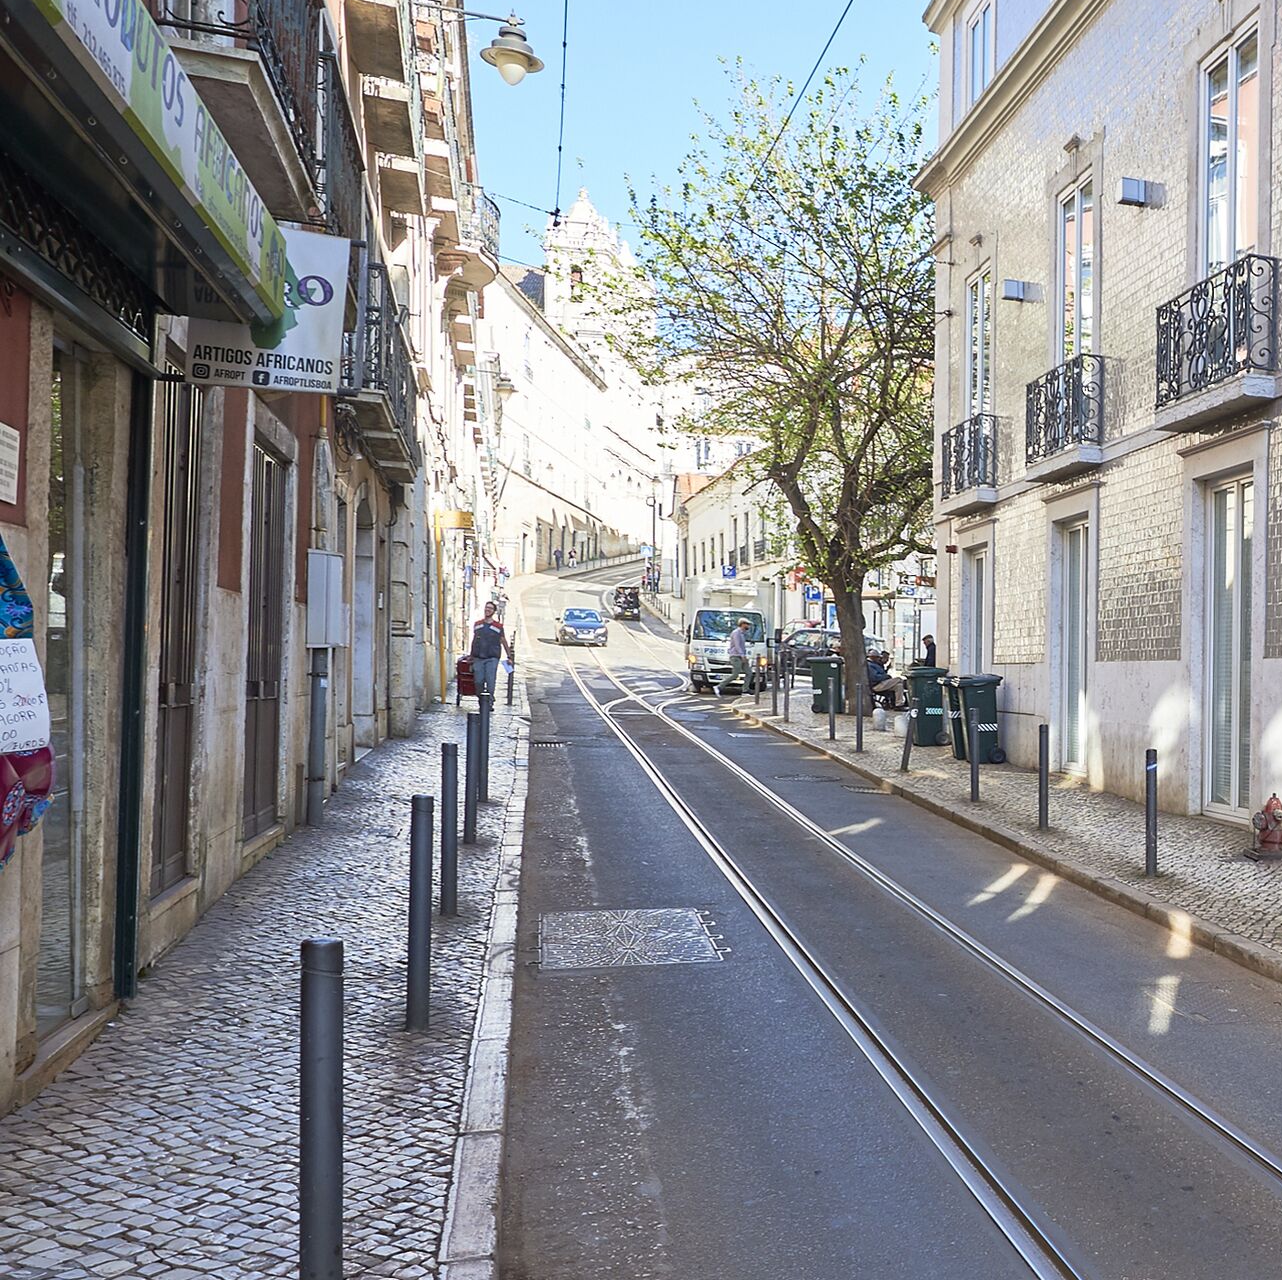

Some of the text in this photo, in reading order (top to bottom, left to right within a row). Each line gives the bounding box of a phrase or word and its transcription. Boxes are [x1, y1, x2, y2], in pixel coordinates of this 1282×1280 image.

[194, 105, 264, 248] AFRICANOS
[193, 344, 333, 375] ARTIGOS AFRICANOS
[214, 368, 246, 381] AFROPT
[273, 375, 332, 390] AFROPTLISBOA
